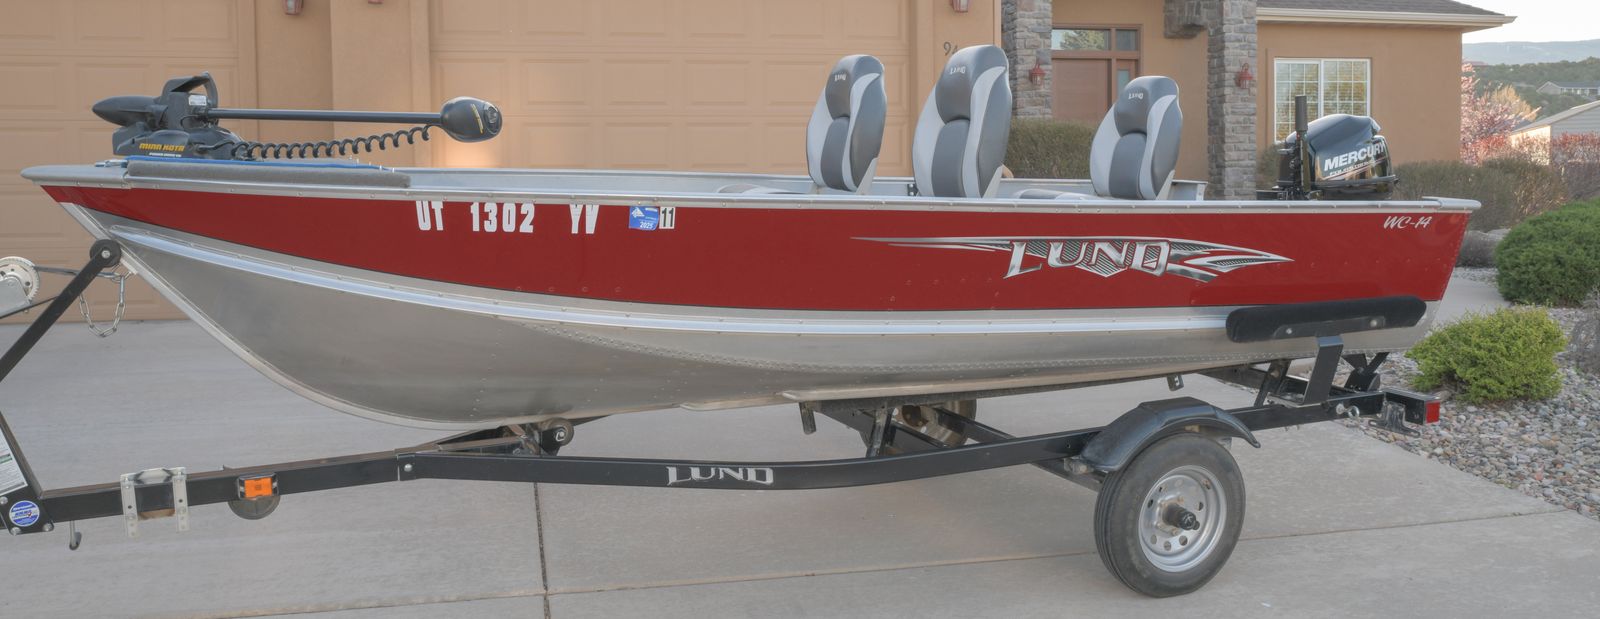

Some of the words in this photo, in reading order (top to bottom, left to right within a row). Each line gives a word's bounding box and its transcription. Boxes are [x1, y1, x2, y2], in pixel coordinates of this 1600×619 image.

[950, 66, 966, 75] LUND
[1128, 92, 1144, 100] LUND
[1324, 141, 1386, 172] MERCURY
[415, 200, 444, 231] UT
[470, 202, 535, 233] 1302
[569, 204, 600, 234] YV
[661, 207, 674, 227] 11
[1383, 216, 1432, 229] WC-14
[1003, 241, 1170, 279] LUND
[666, 466, 774, 486] LUND
